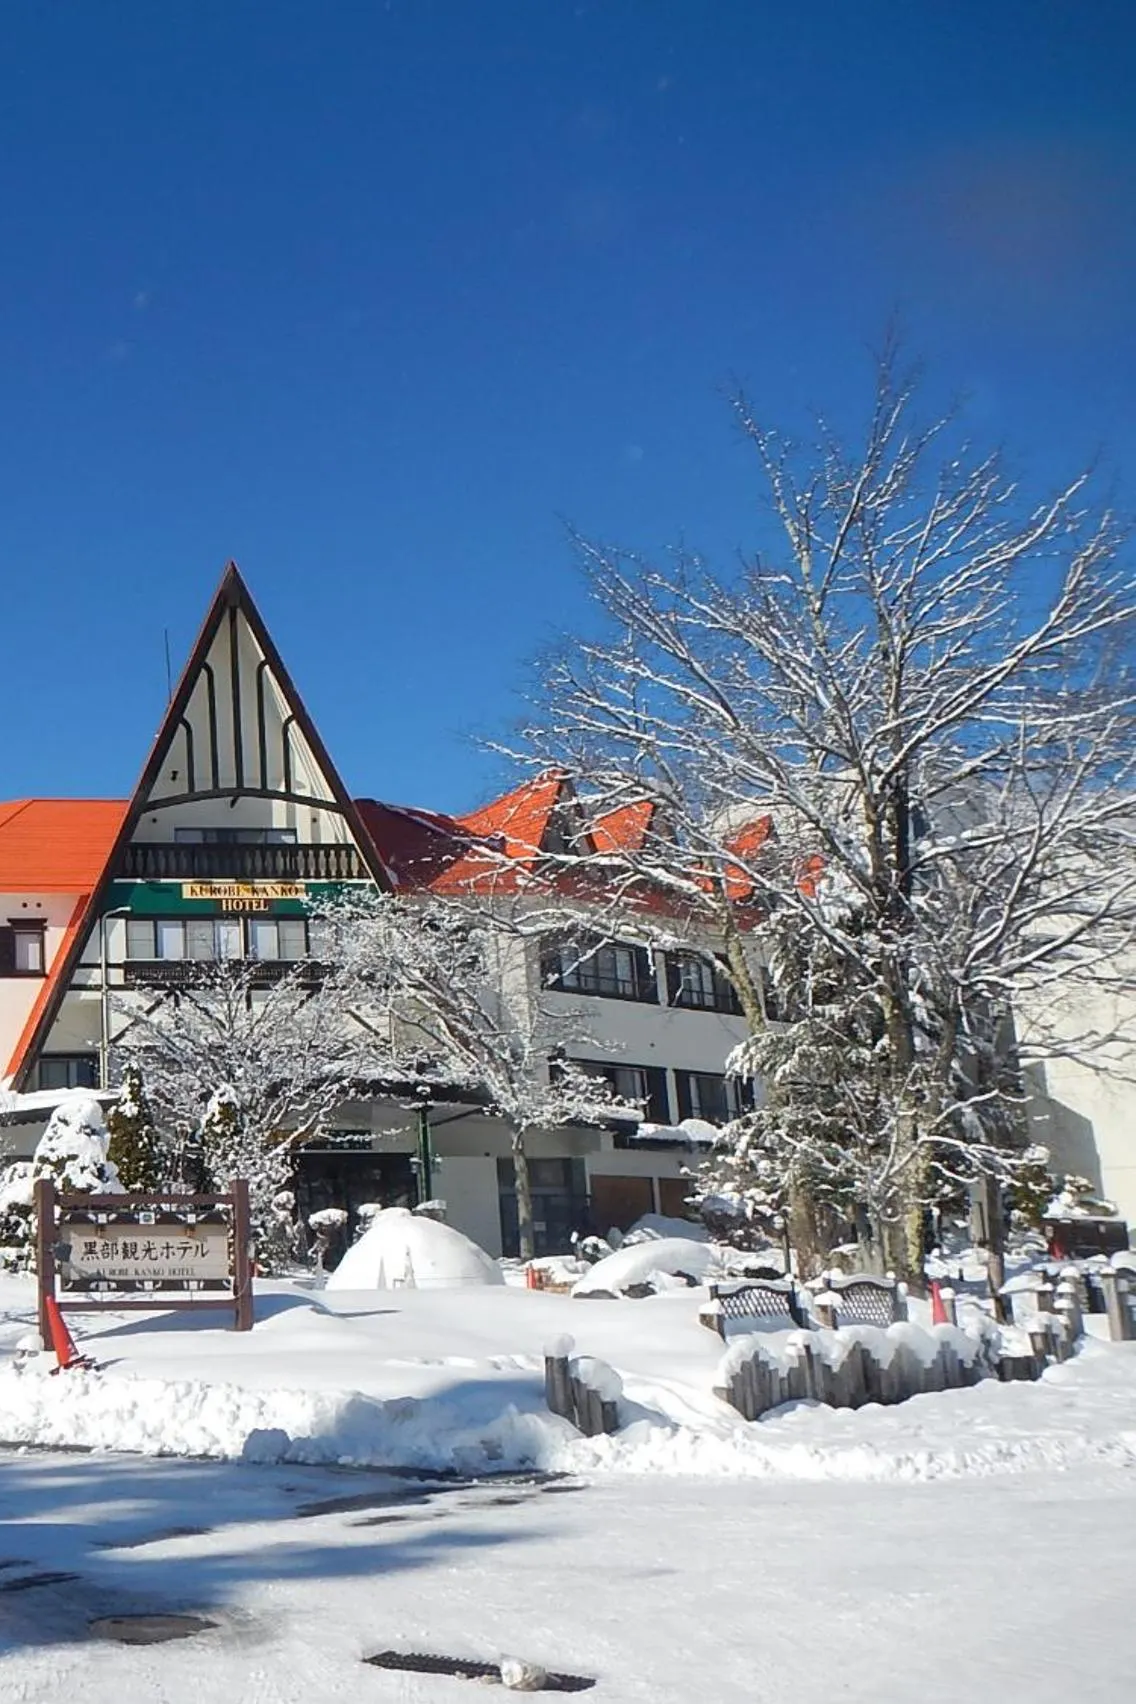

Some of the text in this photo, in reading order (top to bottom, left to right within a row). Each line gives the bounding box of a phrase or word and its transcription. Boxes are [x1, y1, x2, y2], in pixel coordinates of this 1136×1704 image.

[251, 884, 300, 897] KANKO
[221, 899, 269, 912] HOTEL
[80, 1240, 210, 1263] 黒部観光ホテル
